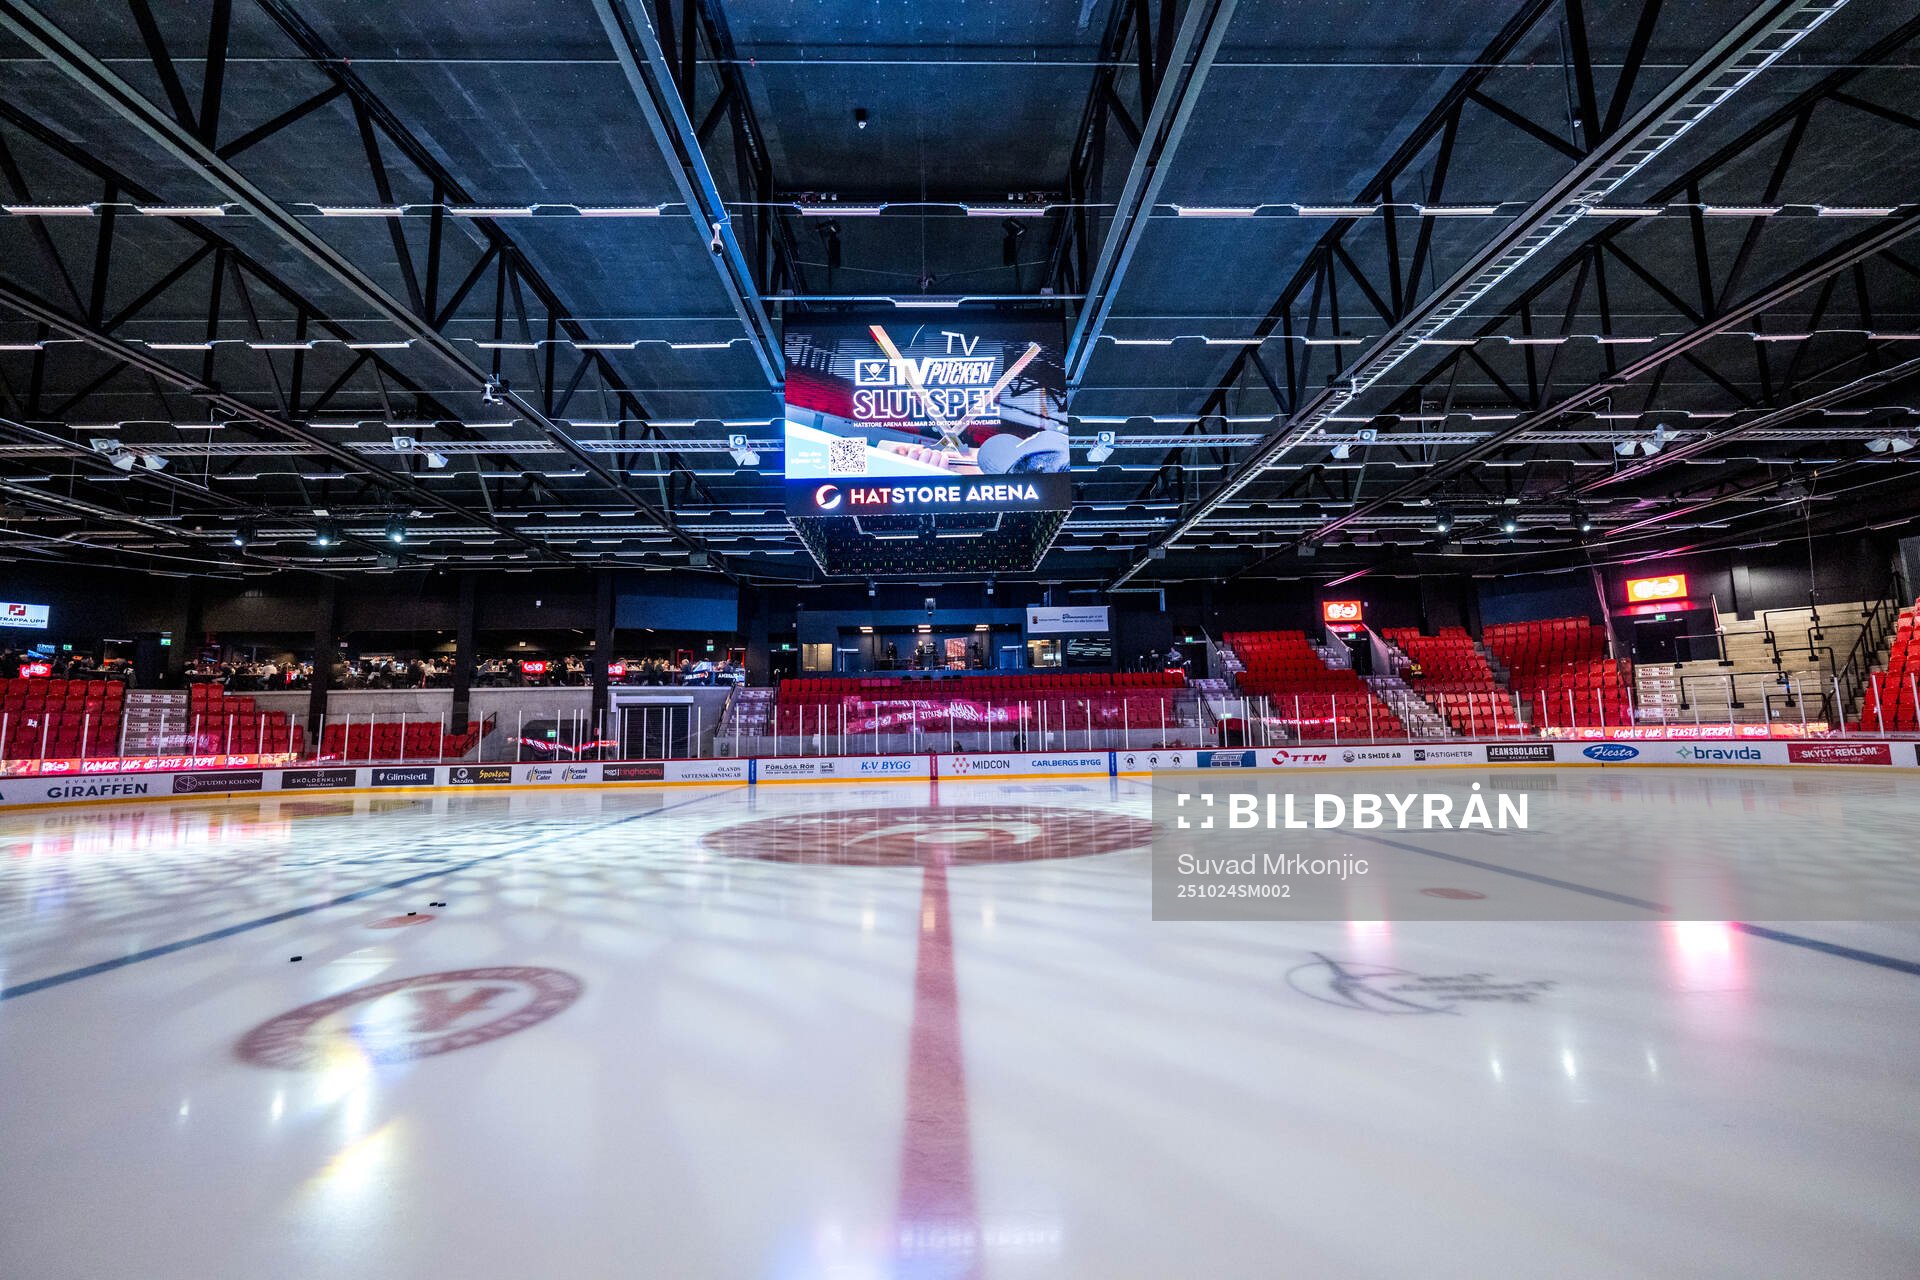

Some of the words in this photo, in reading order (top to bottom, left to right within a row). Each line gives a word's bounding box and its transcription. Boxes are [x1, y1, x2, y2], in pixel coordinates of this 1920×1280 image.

[941, 331, 980, 356] TV
[853, 388, 1000, 420] SLUTSPEL
[850, 486, 961, 504] HATSTORE
[966, 484, 1040, 501] ARENA
[1489, 747, 1549, 756] JEANSBOLAGET
[1591, 746, 1634, 758] Fiesta
[1694, 746, 1761, 759] bravida
[1031, 759, 1079, 767] CARLBERGS
[1290, 754, 1327, 762] TTM
[881, 761, 911, 769] BYGG
[972, 760, 1010, 769] MIDCON
[387, 772, 428, 781] Glimstedt
[47, 783, 148, 799] GIRAFFEN
